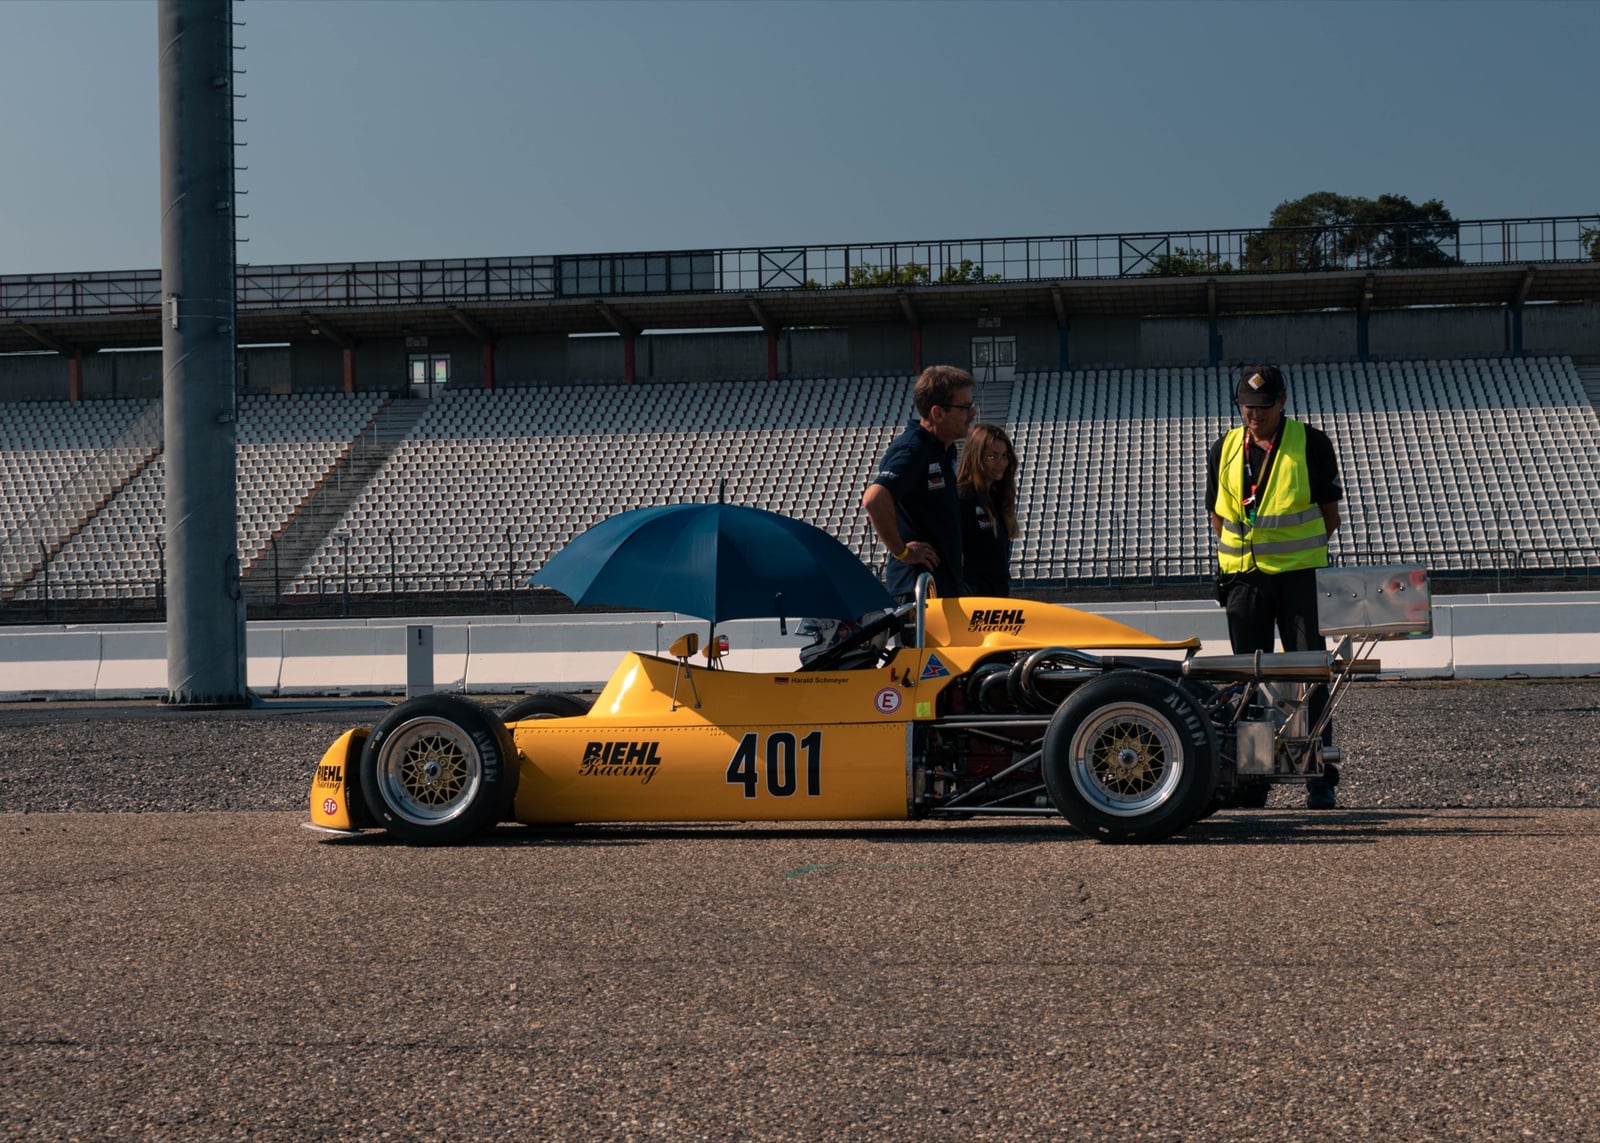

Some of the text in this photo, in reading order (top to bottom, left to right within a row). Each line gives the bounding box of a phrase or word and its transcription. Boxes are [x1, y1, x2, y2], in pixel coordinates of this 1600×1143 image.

[970, 609, 1026, 625] BIEHL
[967, 619, 1024, 637] Racing
[815, 676, 849, 685] Schmeyer
[881, 693, 894, 709] E
[1163, 693, 1207, 747] AVON
[472, 730, 497, 782] AVON
[582, 741, 662, 766] BIEHL
[578, 756, 661, 786] Racing
[725, 730, 823, 800] 401
[323, 799, 338, 814] STP
